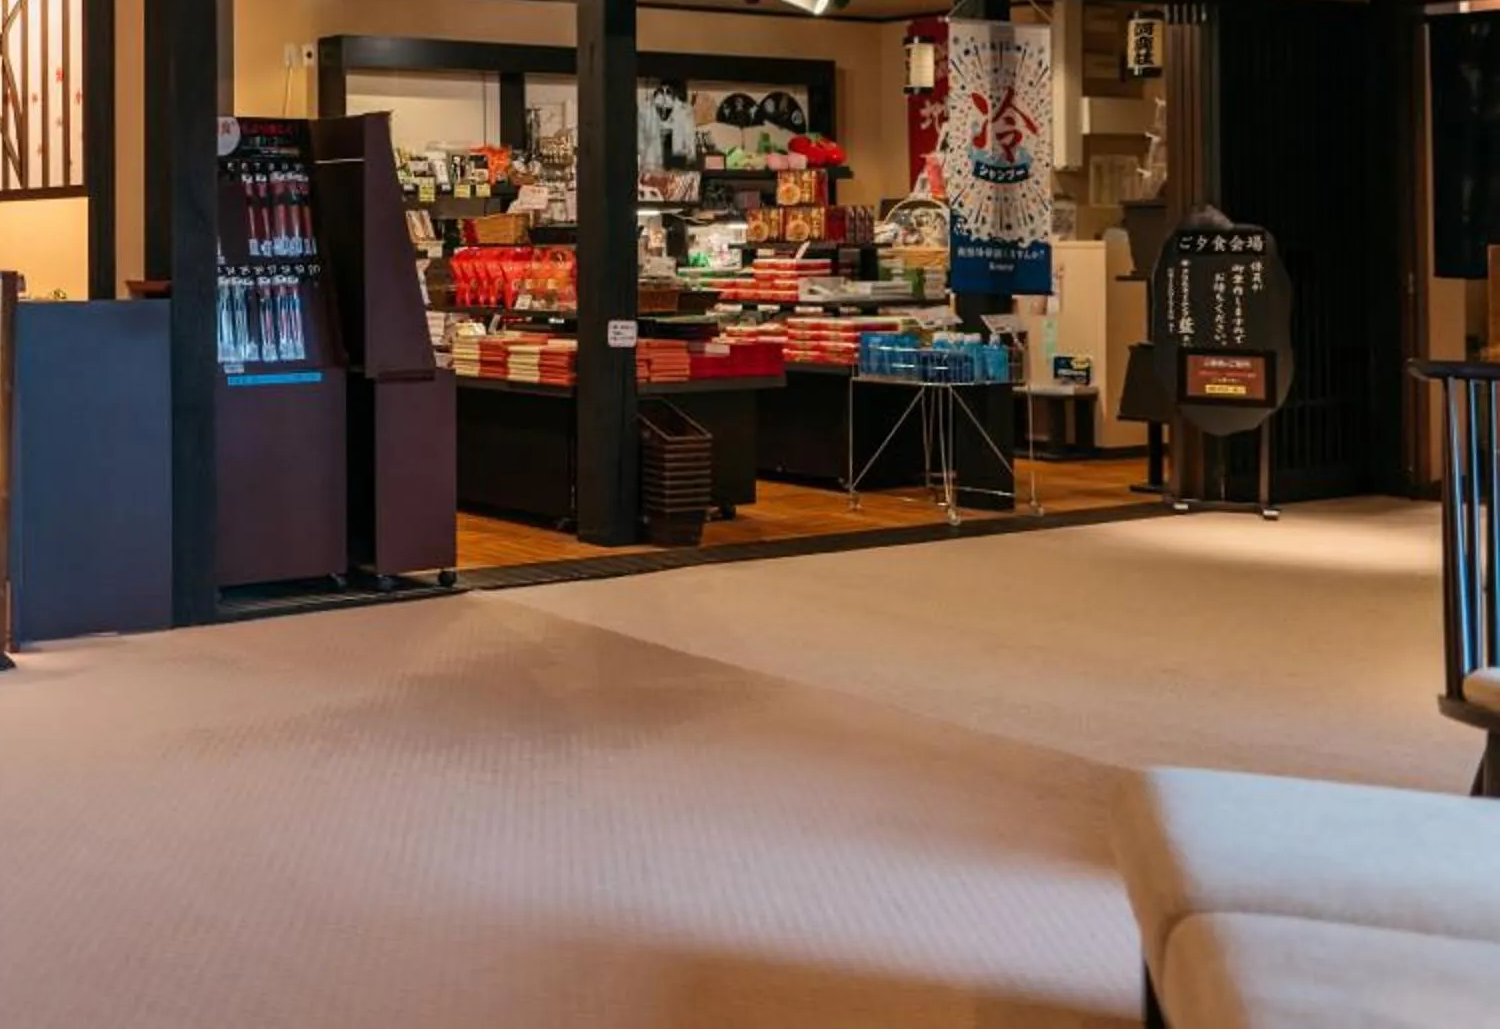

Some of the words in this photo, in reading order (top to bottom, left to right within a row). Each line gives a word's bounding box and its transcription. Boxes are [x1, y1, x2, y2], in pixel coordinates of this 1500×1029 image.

[971, 85, 1039, 163] 冷
[1179, 235, 1263, 252] ご夕食会場
